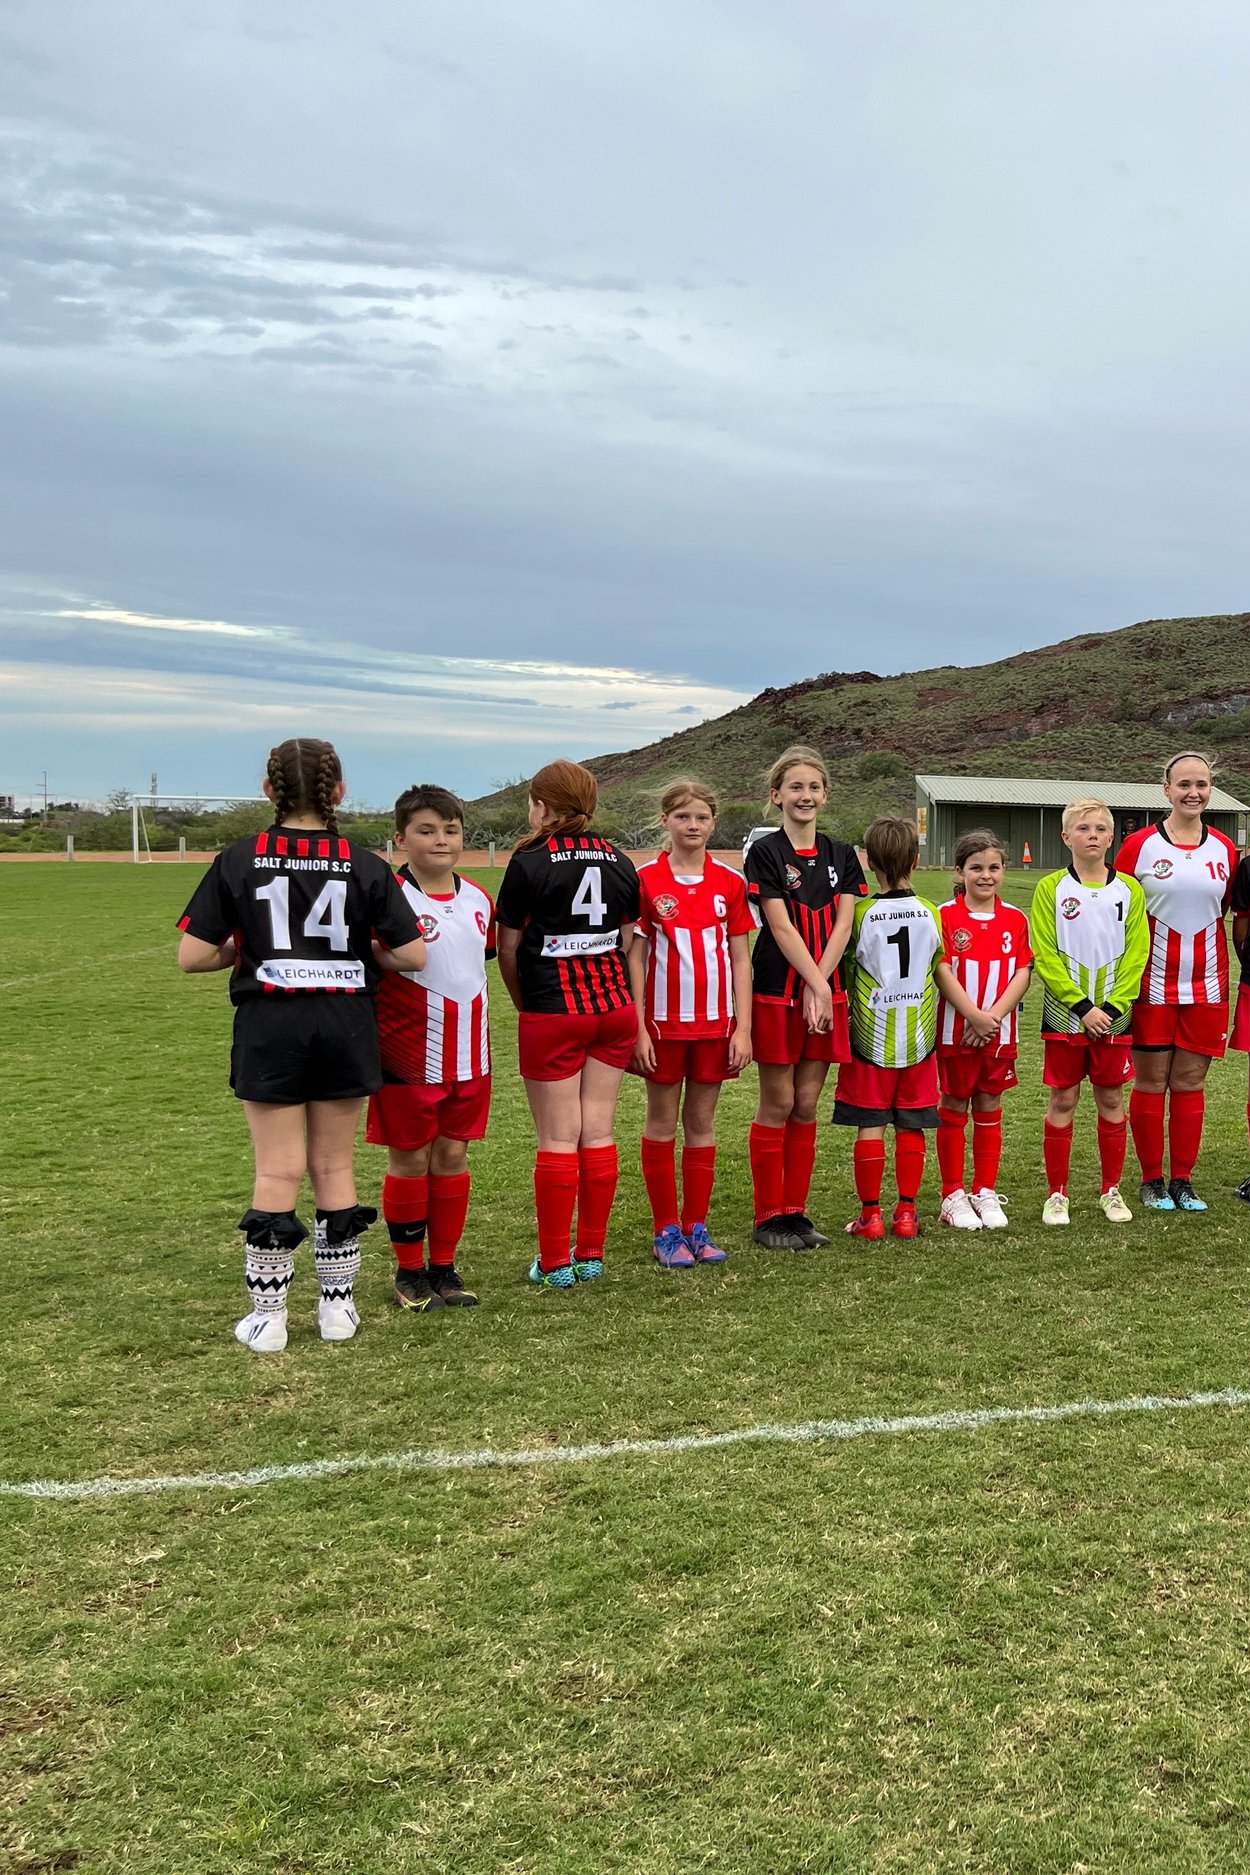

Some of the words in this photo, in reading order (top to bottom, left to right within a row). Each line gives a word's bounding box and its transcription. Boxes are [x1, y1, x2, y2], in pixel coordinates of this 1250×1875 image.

[254, 857, 282, 869] SALT
[284, 858, 329, 871] JUNIOR
[331, 861, 352, 873] S.C
[550, 850, 572, 863] SALT
[573, 850, 604, 861] JUNIOR
[827, 865, 839, 888] 5
[1205, 860, 1228, 882] 16
[571, 866, 608, 926] 4
[713, 894, 727, 918] 6
[255, 876, 350, 952] 14
[869, 912, 887, 923] SALT
[888, 910, 916, 921] JUNIOR
[917, 910, 929, 918] S.C
[1114, 900, 1123, 922] 1
[474, 910, 487, 937] 6
[886, 925, 911, 980] 1
[1001, 931, 1013, 954] 3
[276, 968, 362, 980] LEICHHARDT
